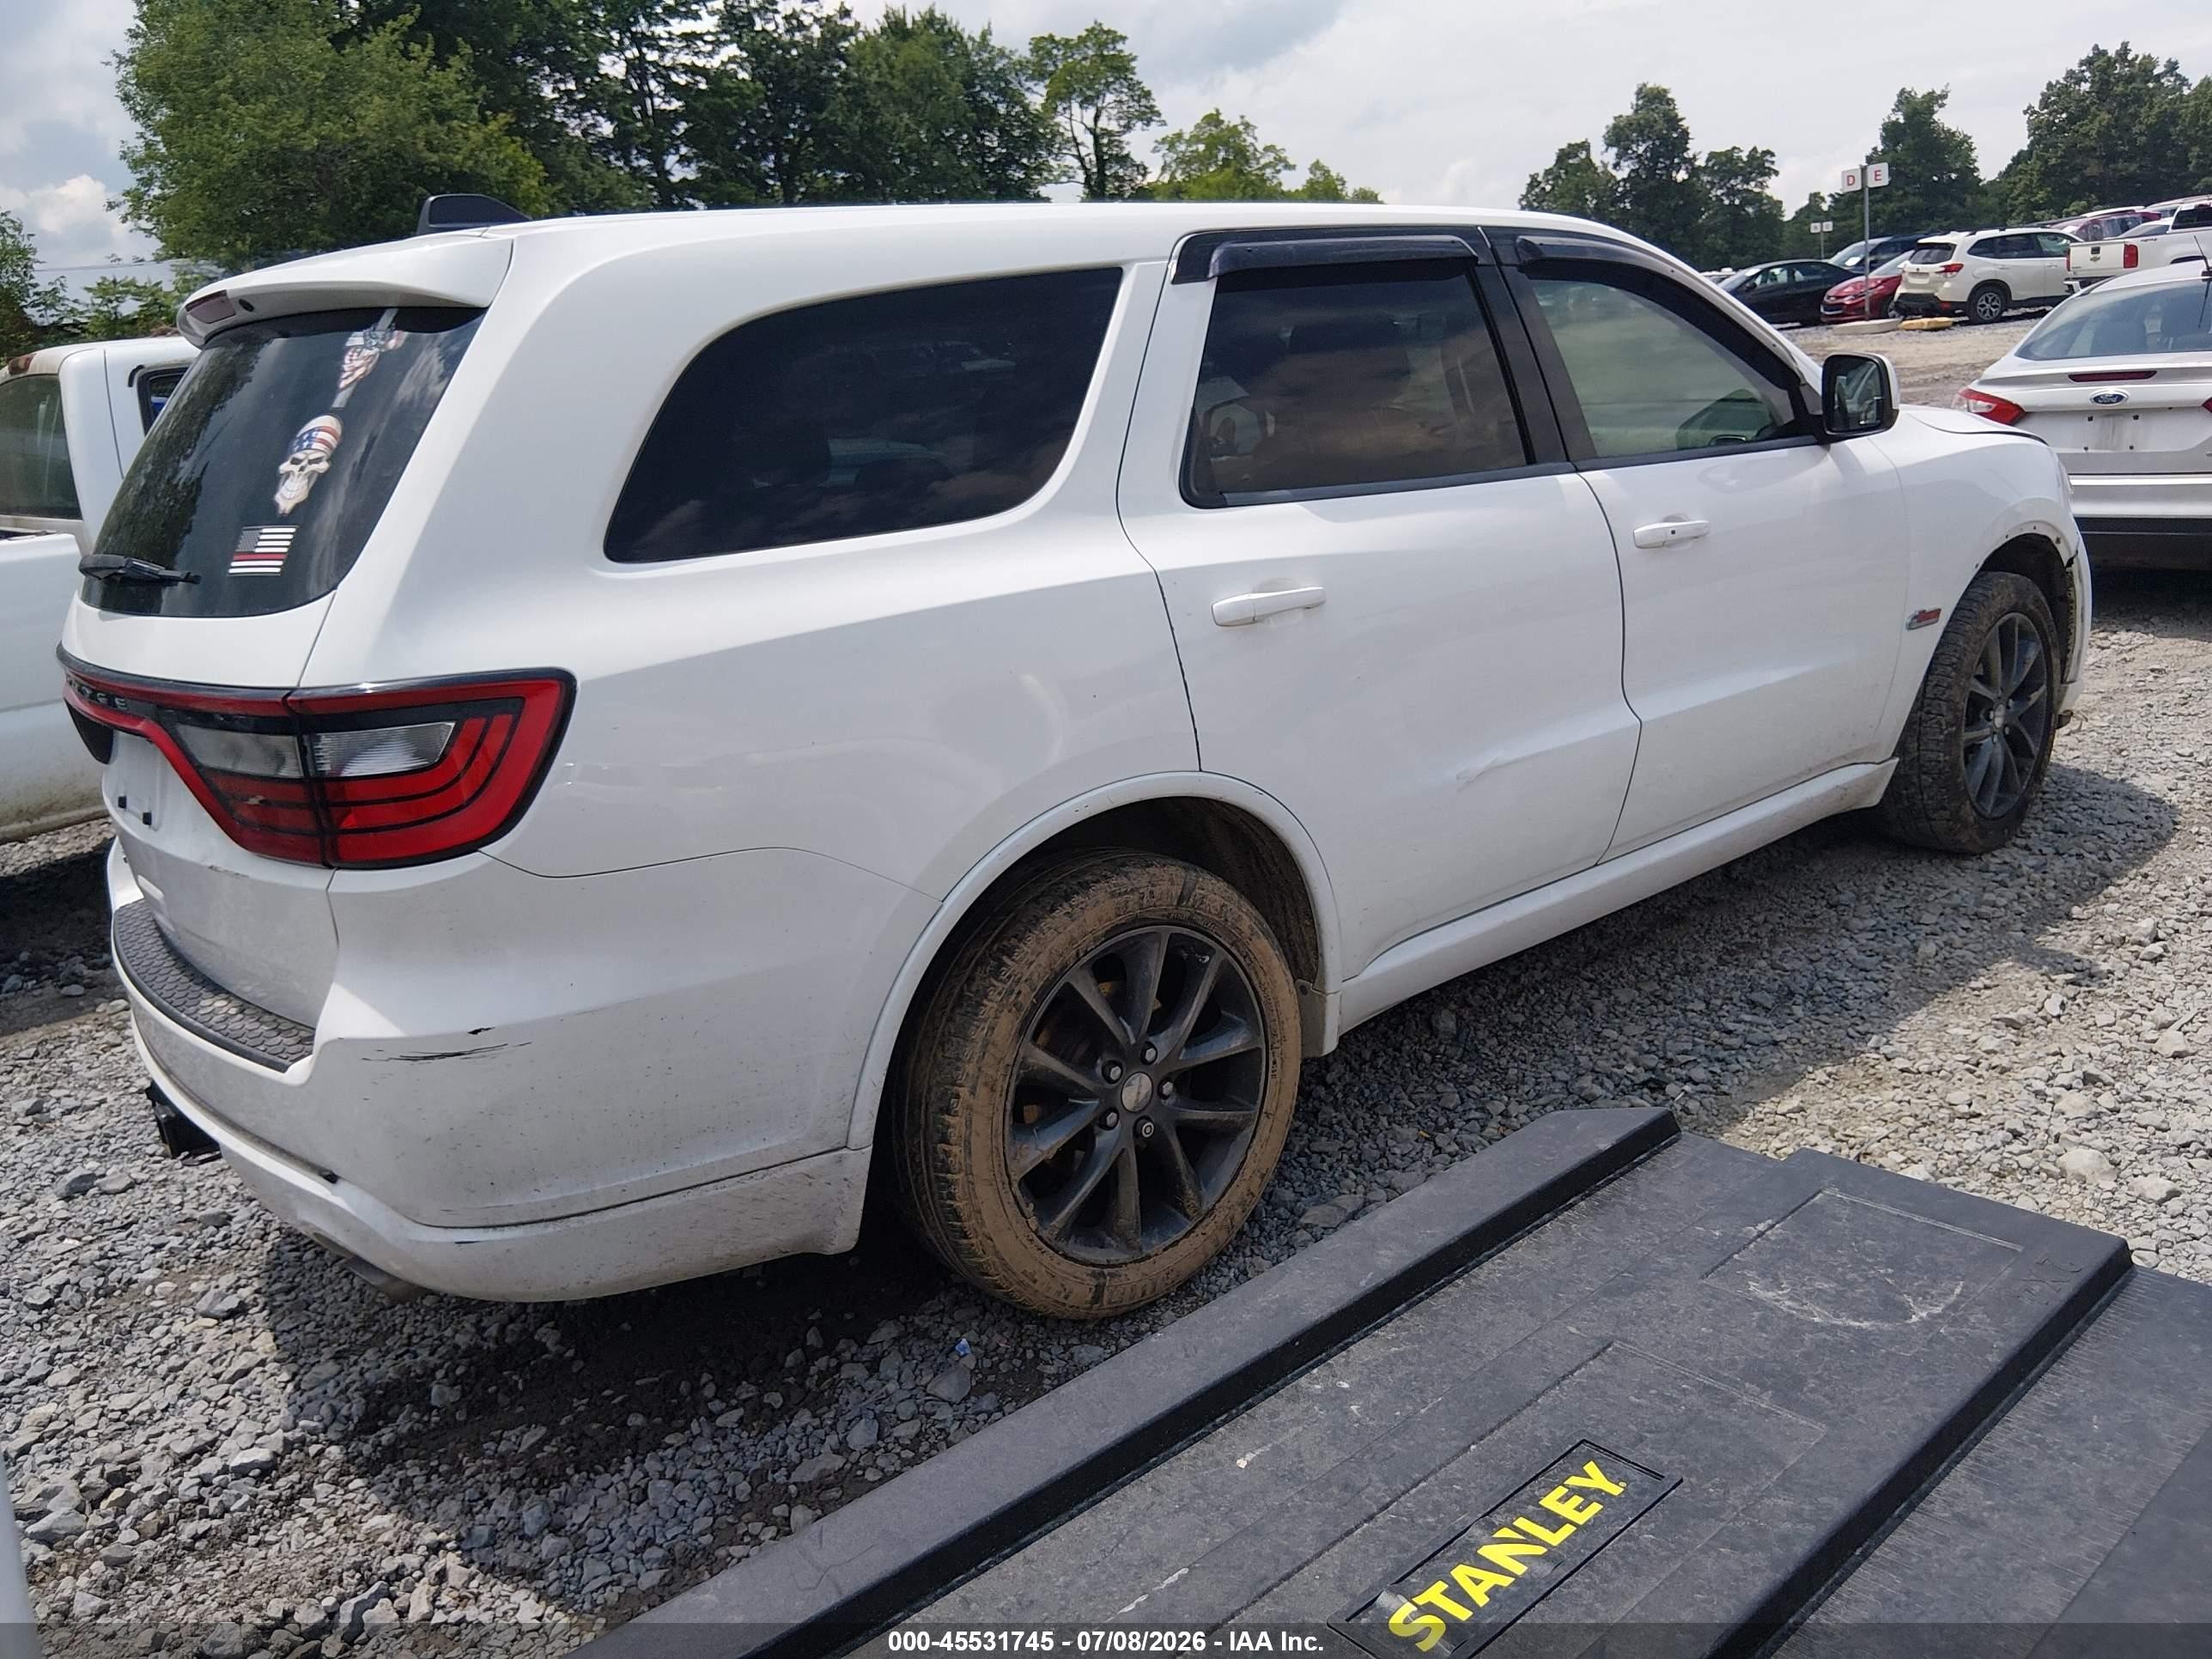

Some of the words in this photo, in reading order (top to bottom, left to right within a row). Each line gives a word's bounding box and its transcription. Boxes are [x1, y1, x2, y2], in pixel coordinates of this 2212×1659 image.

[1847, 174, 1856, 186] D
[1875, 169, 1882, 181] E
[1388, 1460, 1625, 1652] STANLEY
